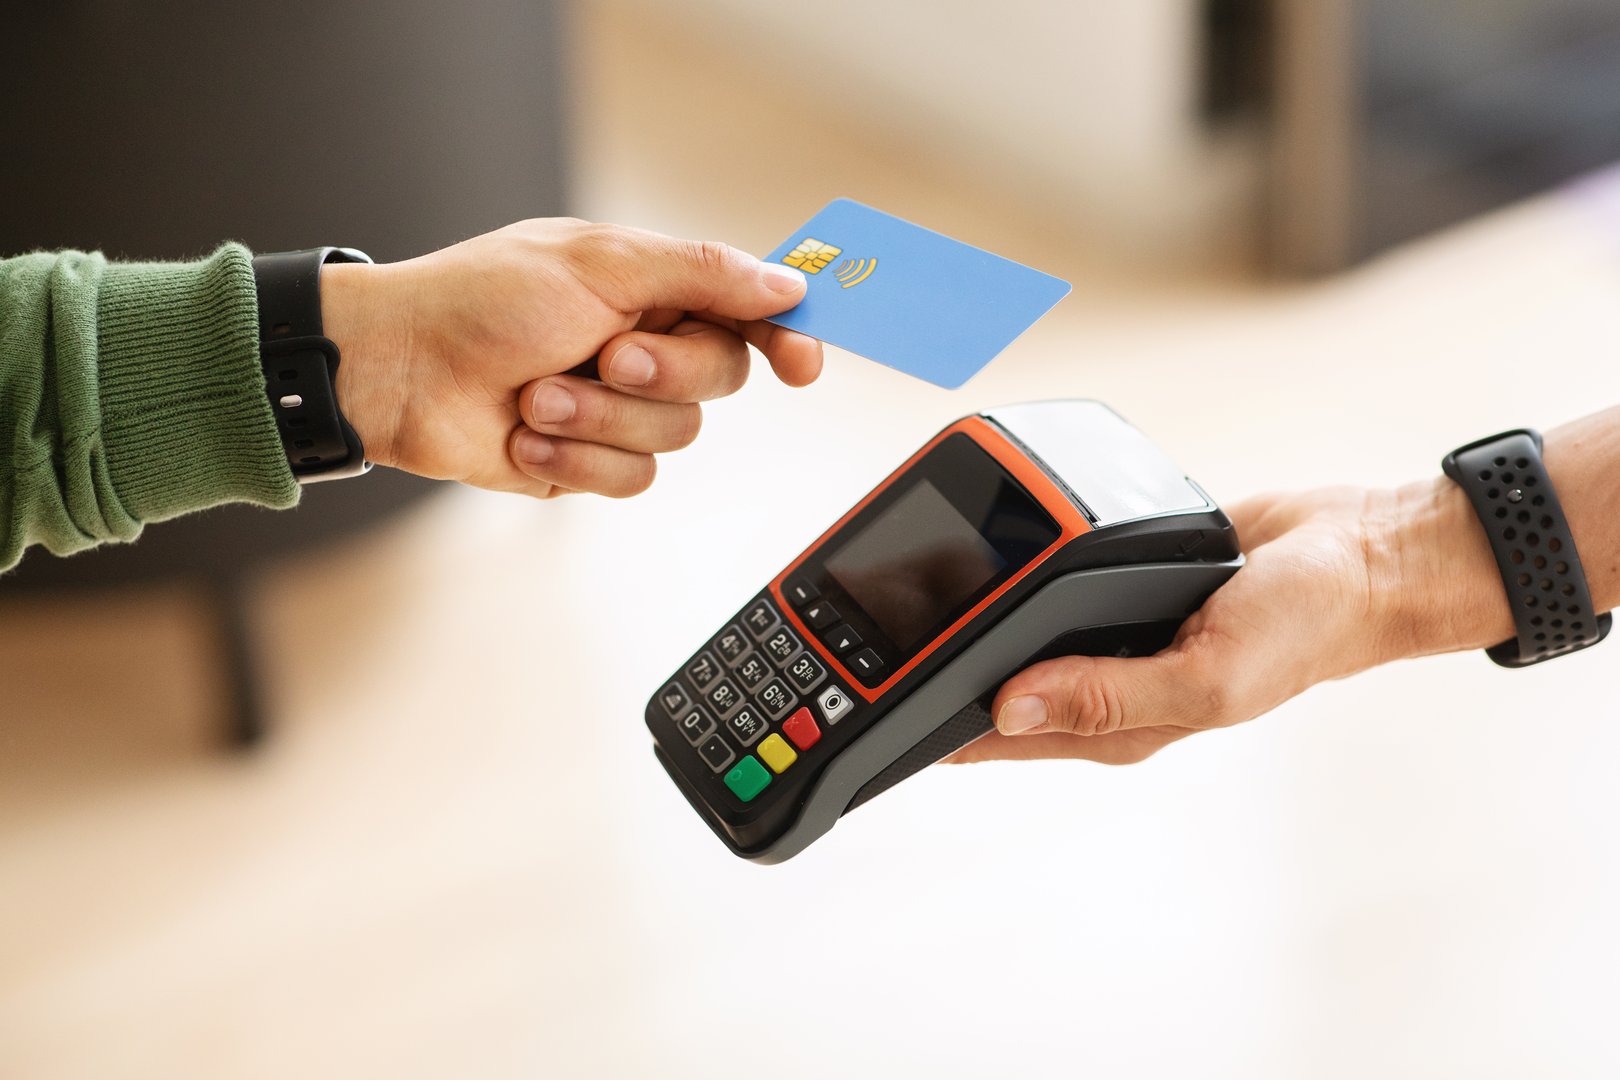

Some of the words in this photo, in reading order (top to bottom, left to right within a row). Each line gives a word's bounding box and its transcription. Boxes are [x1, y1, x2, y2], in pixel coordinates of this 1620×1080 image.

[751, 608, 765, 622] 1
[721, 635, 736, 648] 4
[769, 634, 787, 650] 2
[693, 659, 708, 672] 7
[742, 660, 758, 676] 5
[793, 660, 809, 674] 3
[805, 667, 814, 680] DE
[713, 685, 729, 701] 8
[763, 685, 779, 700] 6
[684, 712, 700, 728] 0
[734, 711, 750, 727] 9
